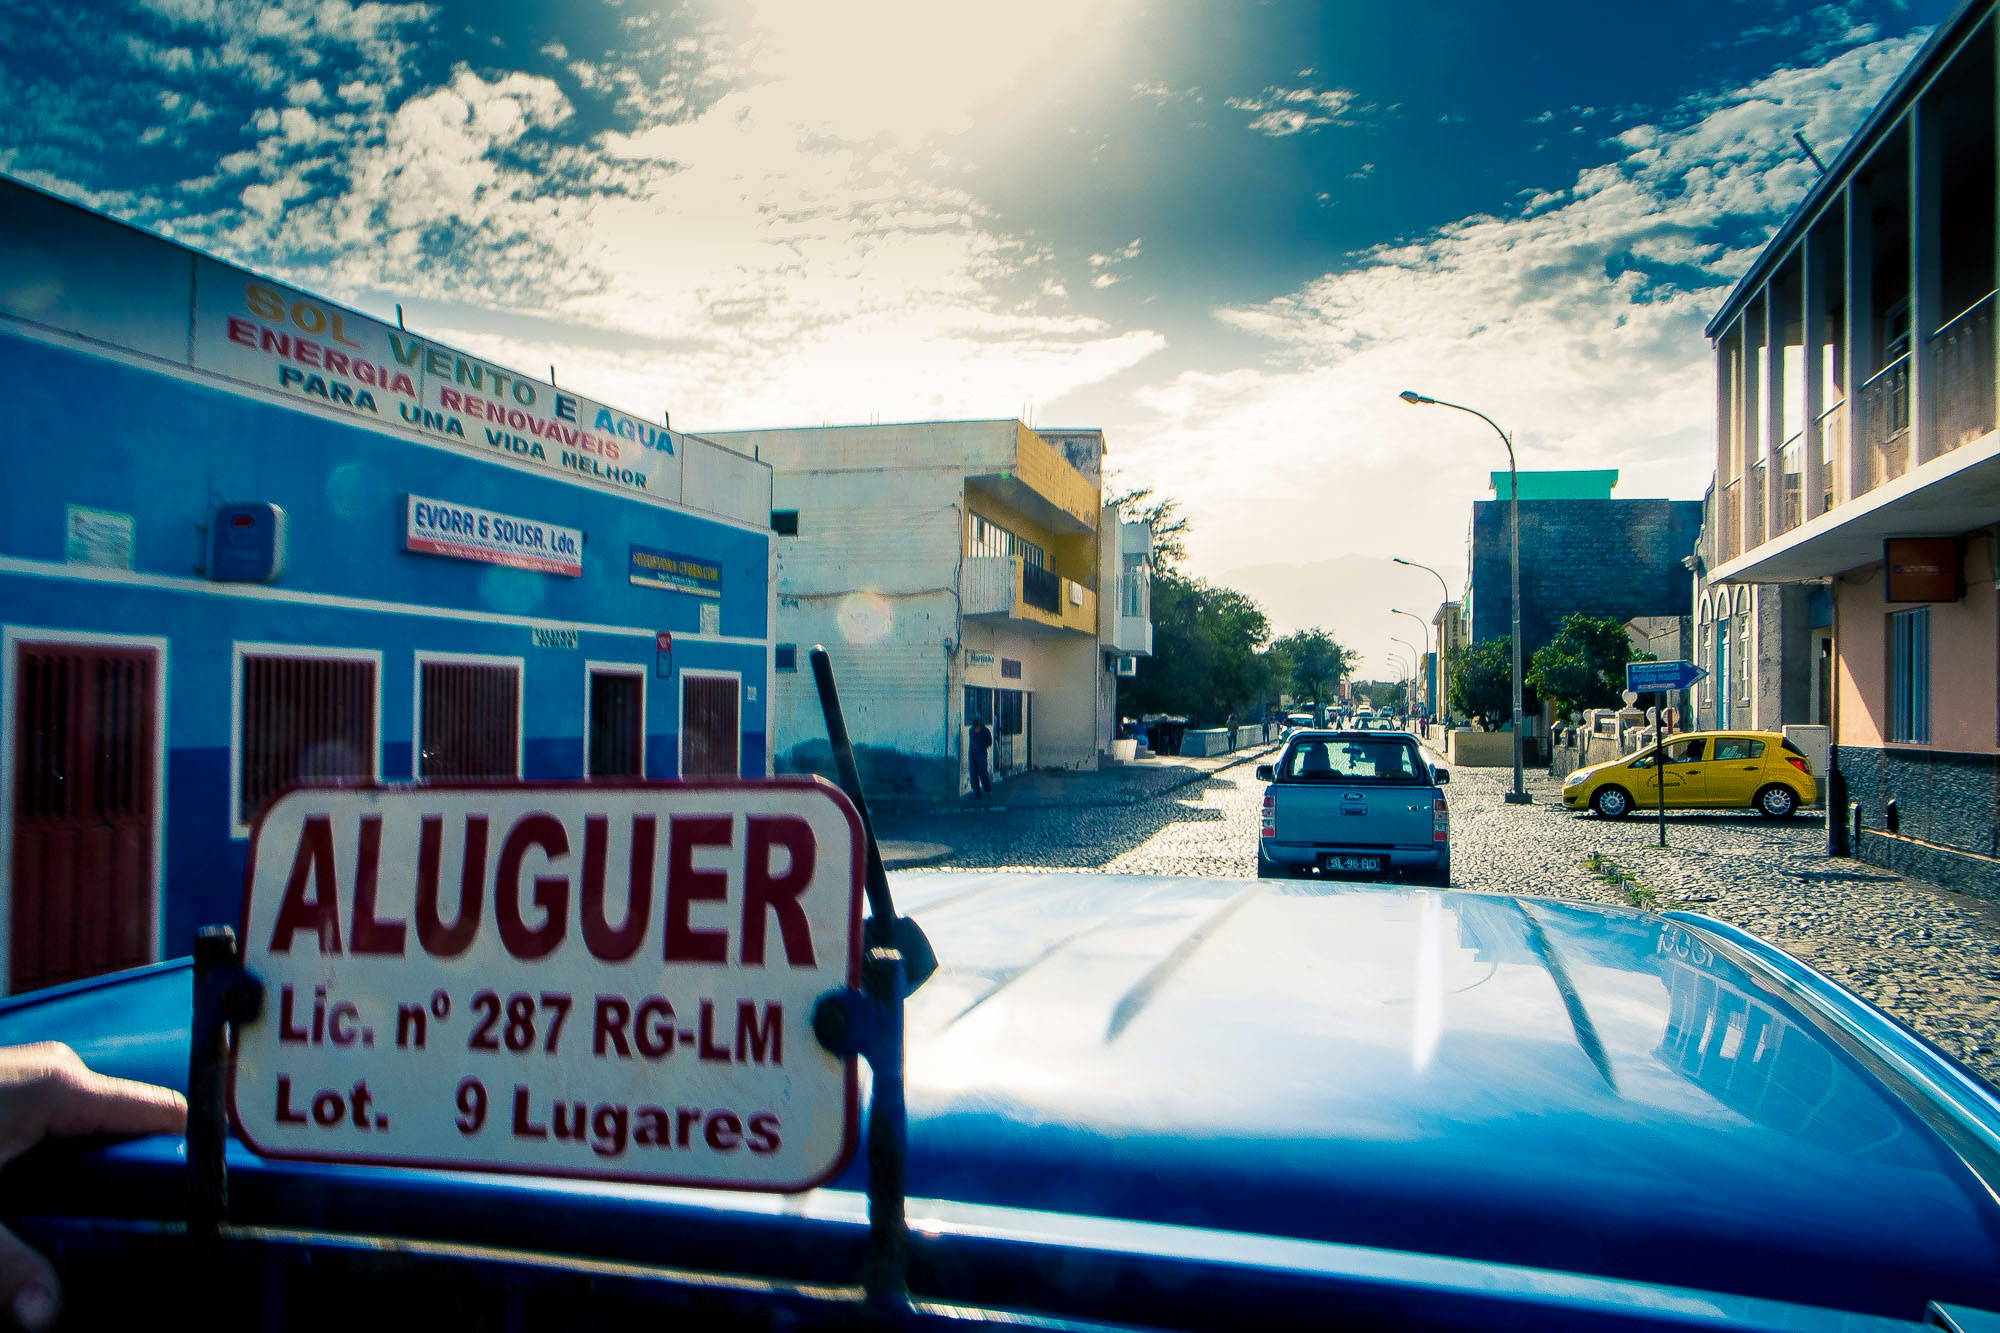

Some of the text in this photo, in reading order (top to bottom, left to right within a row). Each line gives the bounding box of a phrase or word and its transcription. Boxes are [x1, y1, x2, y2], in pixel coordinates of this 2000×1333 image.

[227, 315, 620, 461] ENERGIA RENOVÁVEIS
[246, 283, 362, 350] SOL
[387, 331, 537, 406] VENTO
[555, 391, 577, 423] E
[278, 363, 648, 490] PARA UMA VIDA MELHOR
[269, 811, 818, 969] ALUGUER
[277, 983, 374, 1048] Lic.
[468, 990, 572, 1054] 287
[592, 993, 783, 1066] RG-LM
[275, 1073, 782, 1158] Lot. 9 Lugares
